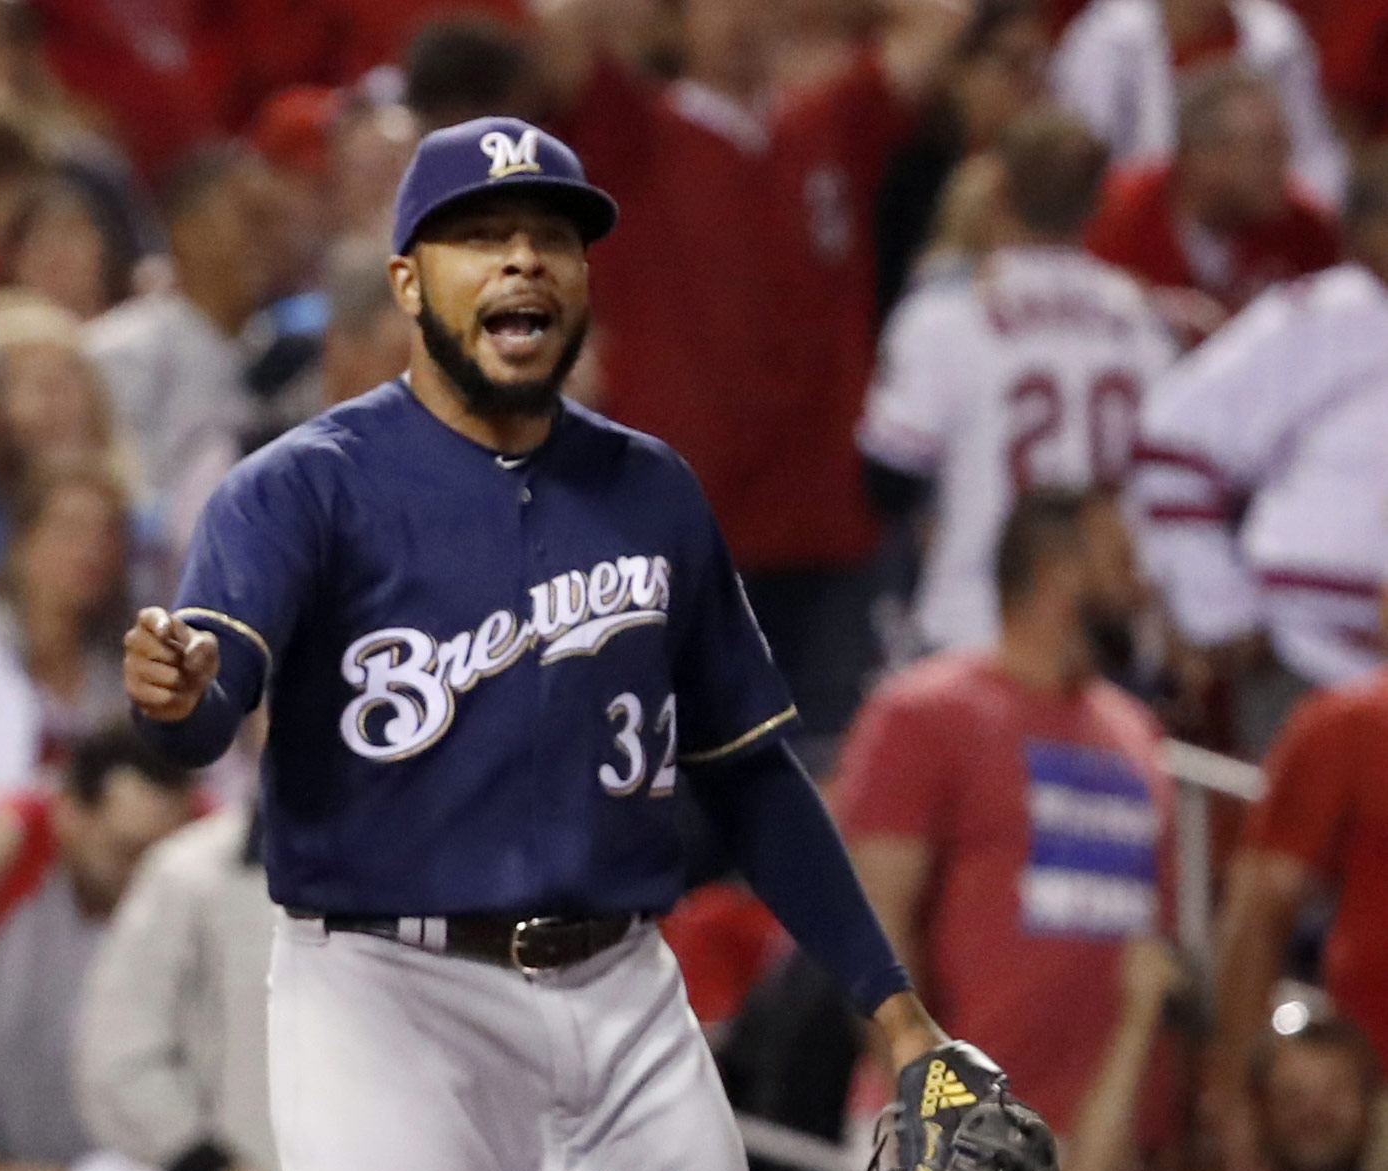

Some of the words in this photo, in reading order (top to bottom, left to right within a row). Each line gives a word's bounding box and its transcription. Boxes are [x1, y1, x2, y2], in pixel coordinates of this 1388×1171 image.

[1008, 370, 1141, 491] 20
[340, 554, 670, 763] Brewers
[599, 692, 677, 797] 32
[920, 1060, 947, 1118] adidas
